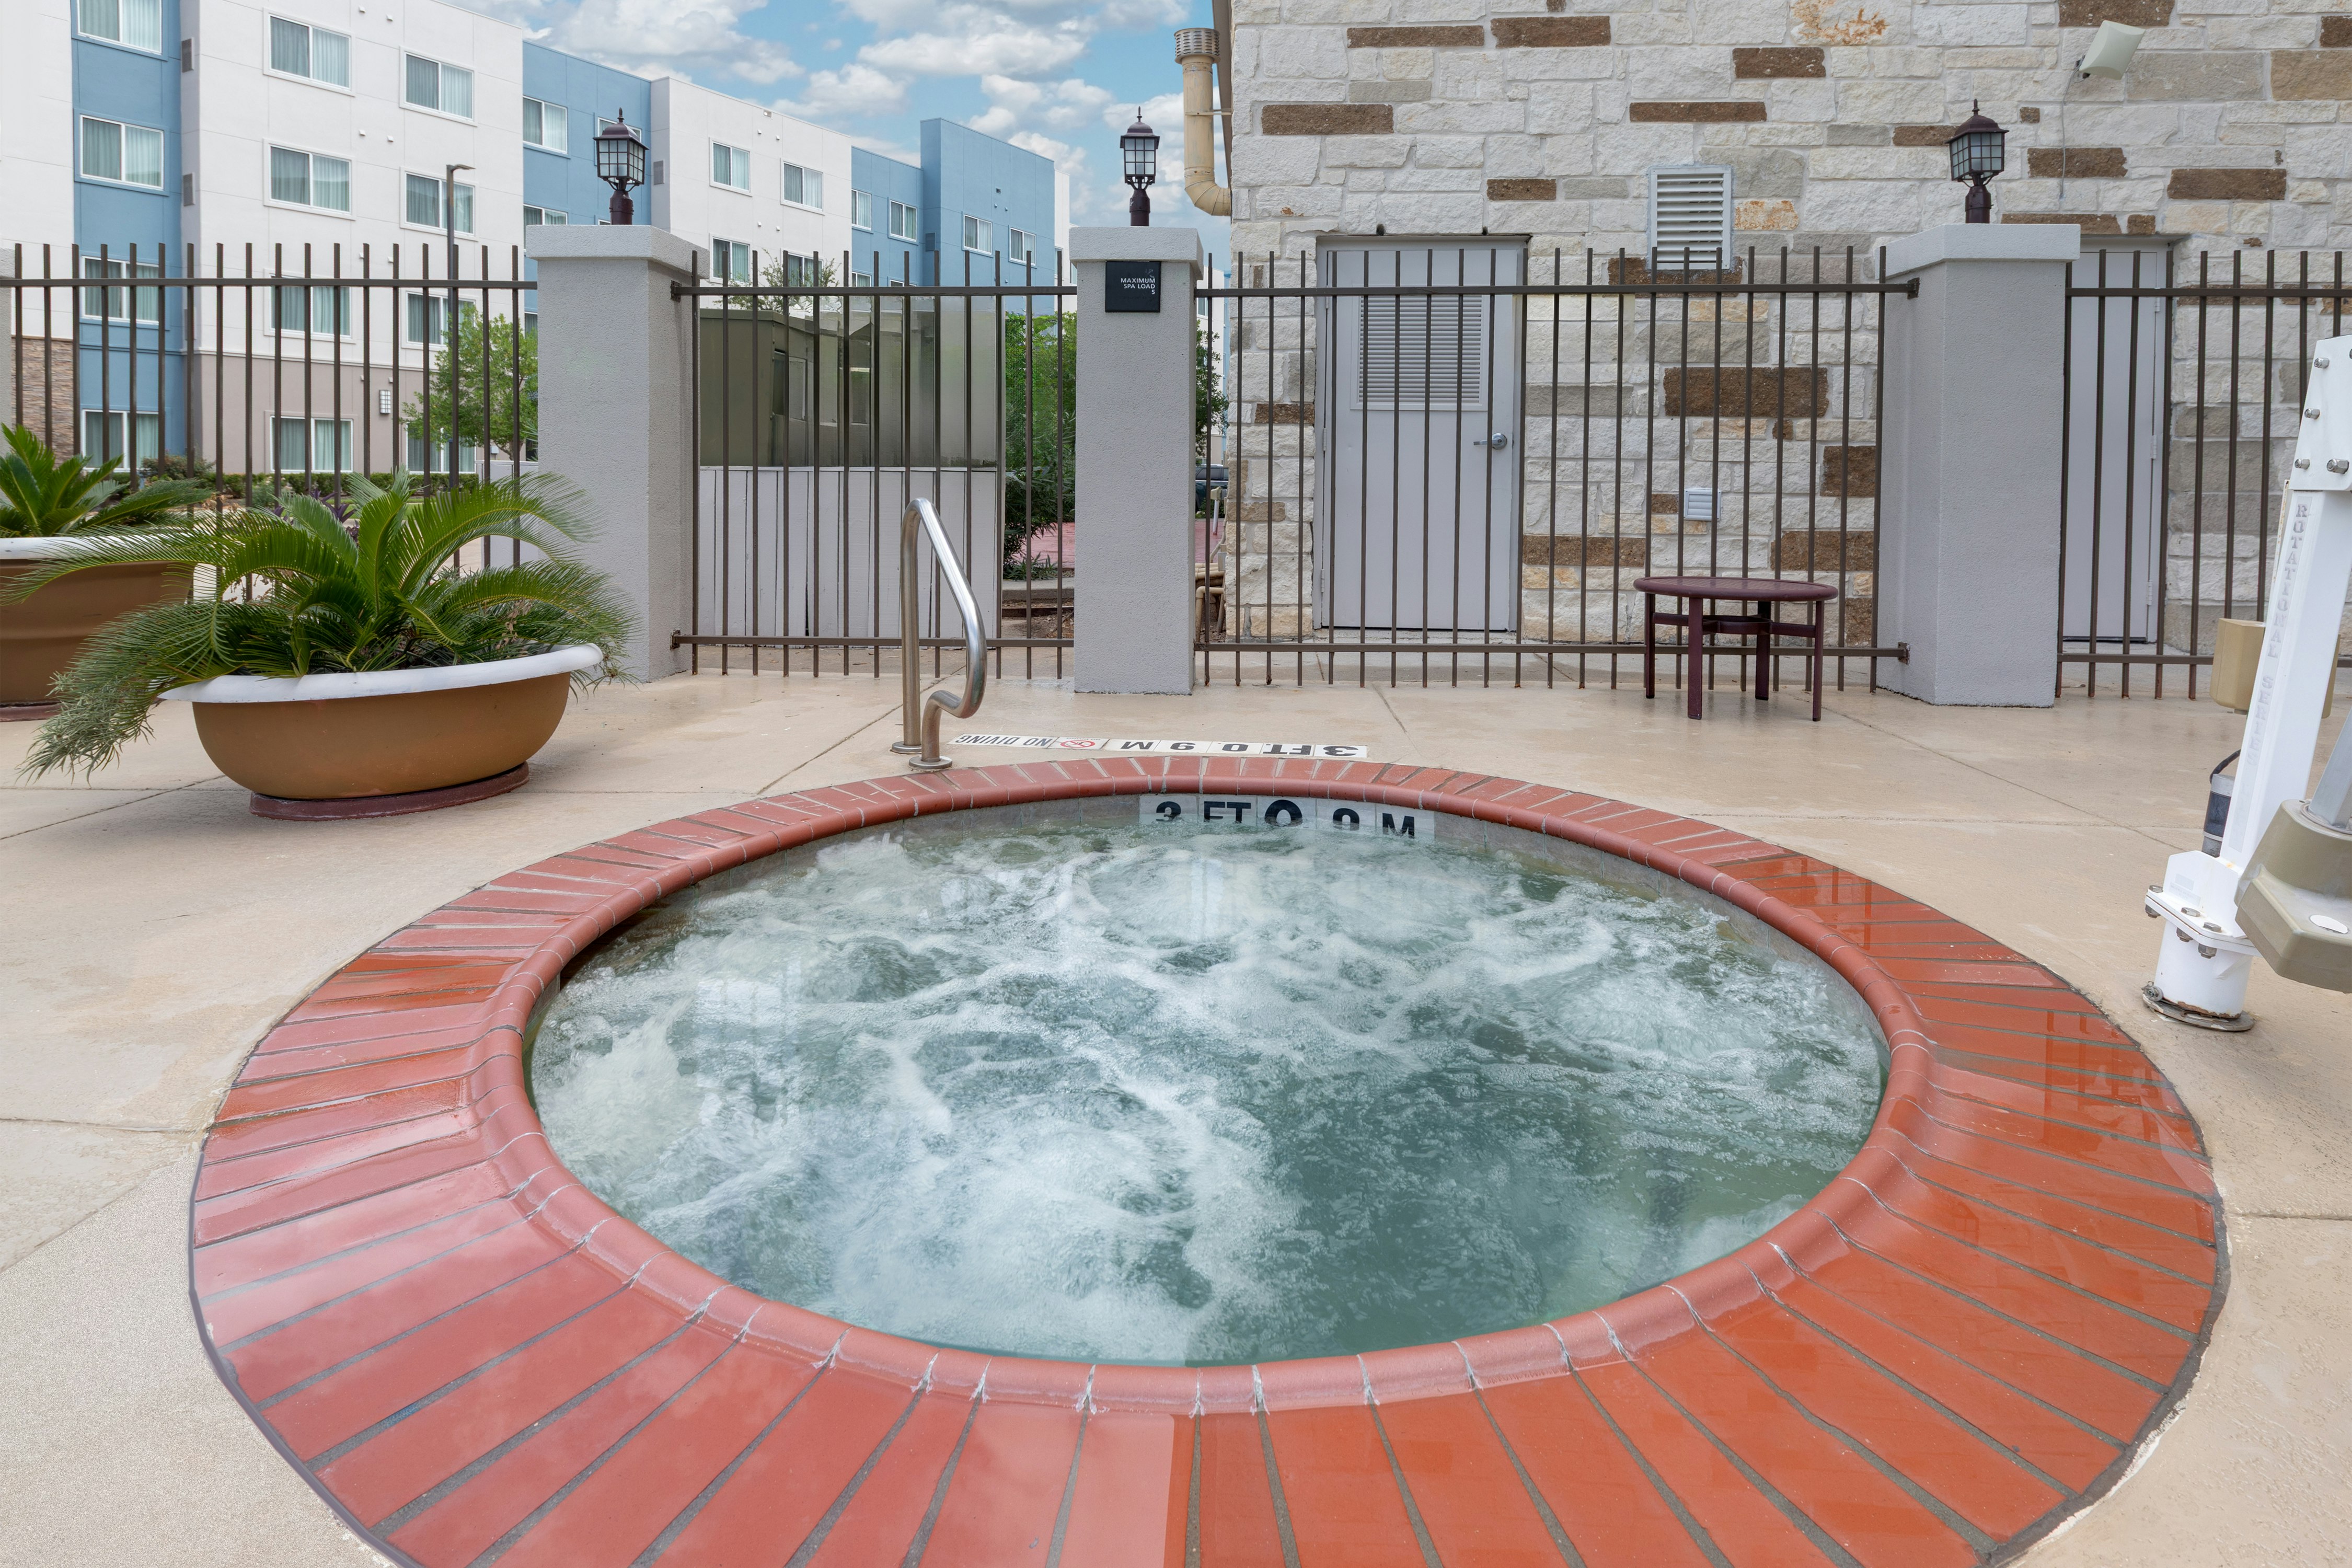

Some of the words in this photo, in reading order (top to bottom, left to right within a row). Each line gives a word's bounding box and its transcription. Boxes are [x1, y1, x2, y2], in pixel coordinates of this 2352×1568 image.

[2267, 503, 2308, 659] ROTATIONAL
[955, 735, 1019, 745] DIVING
[1023, 737, 1053, 746] NO
[1121, 741, 1154, 750] M
[1323, 746, 1358, 756] 3
[1204, 801, 1251, 824] FT
